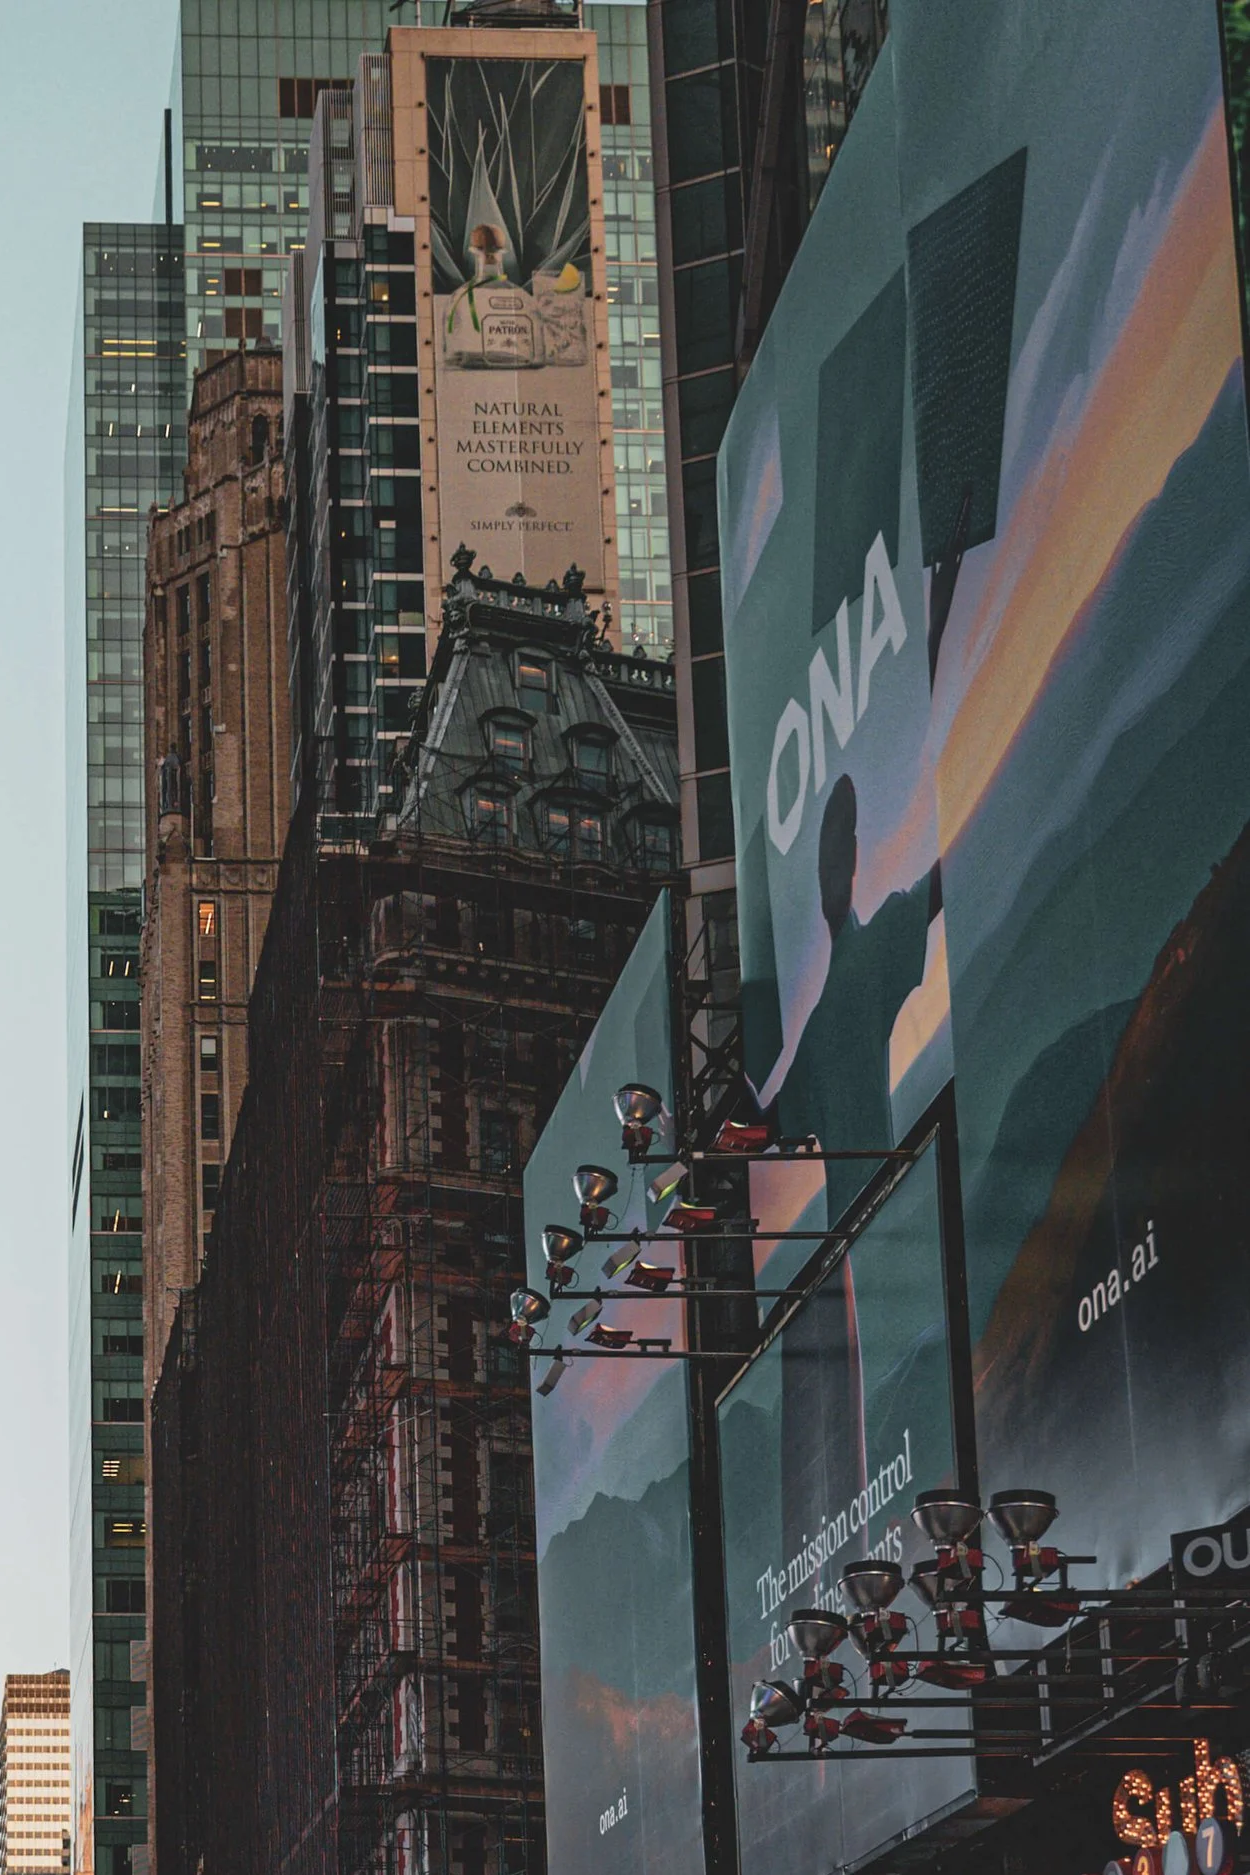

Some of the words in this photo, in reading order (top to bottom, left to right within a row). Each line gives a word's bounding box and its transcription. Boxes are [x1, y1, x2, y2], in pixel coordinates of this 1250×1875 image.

[474, 401, 563, 418] NATURAL
[472, 421, 565, 436] ELEMENTS
[456, 439, 584, 456] MASTERFULLY
[467, 459, 573, 474] COMBINED.
[470, 521, 515, 532] SIMPLY
[766, 529, 908, 856] ONA
[1077, 1219, 1159, 1332] ona.ai
[756, 1565, 788, 1620] The
[787, 1514, 849, 1598] mission
[849, 1428, 913, 1534] control
[599, 1786, 629, 1836] ona.ai
[1201, 1826, 1215, 1869] 7
